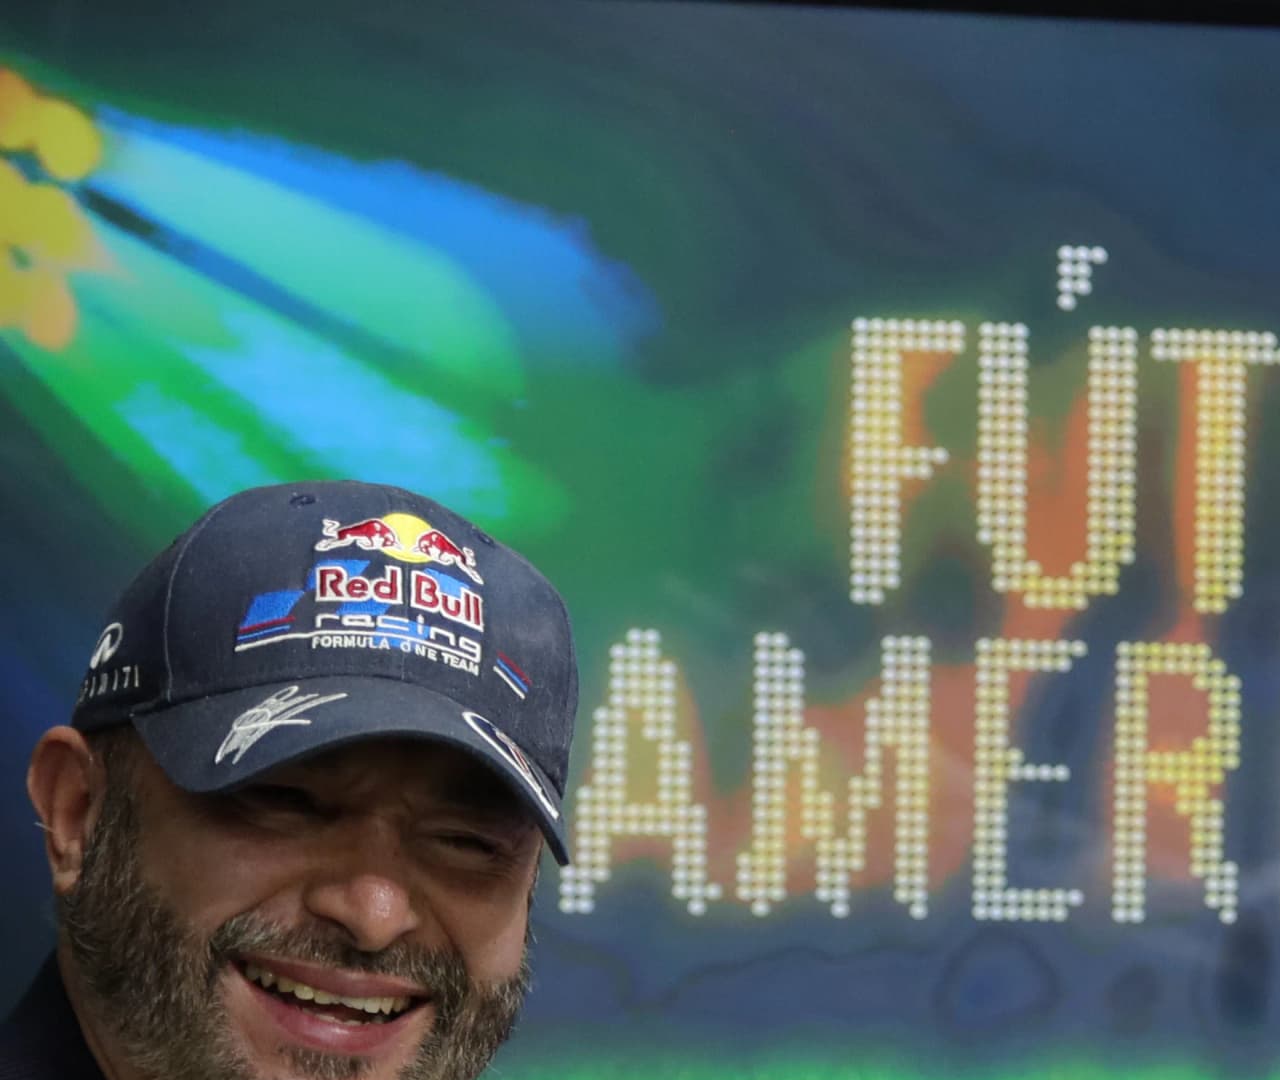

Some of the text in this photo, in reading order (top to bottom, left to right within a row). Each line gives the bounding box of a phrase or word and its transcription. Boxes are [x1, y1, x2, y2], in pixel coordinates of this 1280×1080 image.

[314, 565, 485, 633] Red Bull
[311, 635, 480, 677] FORMULA ONE TEAM
[314, 613, 482, 664] racing
